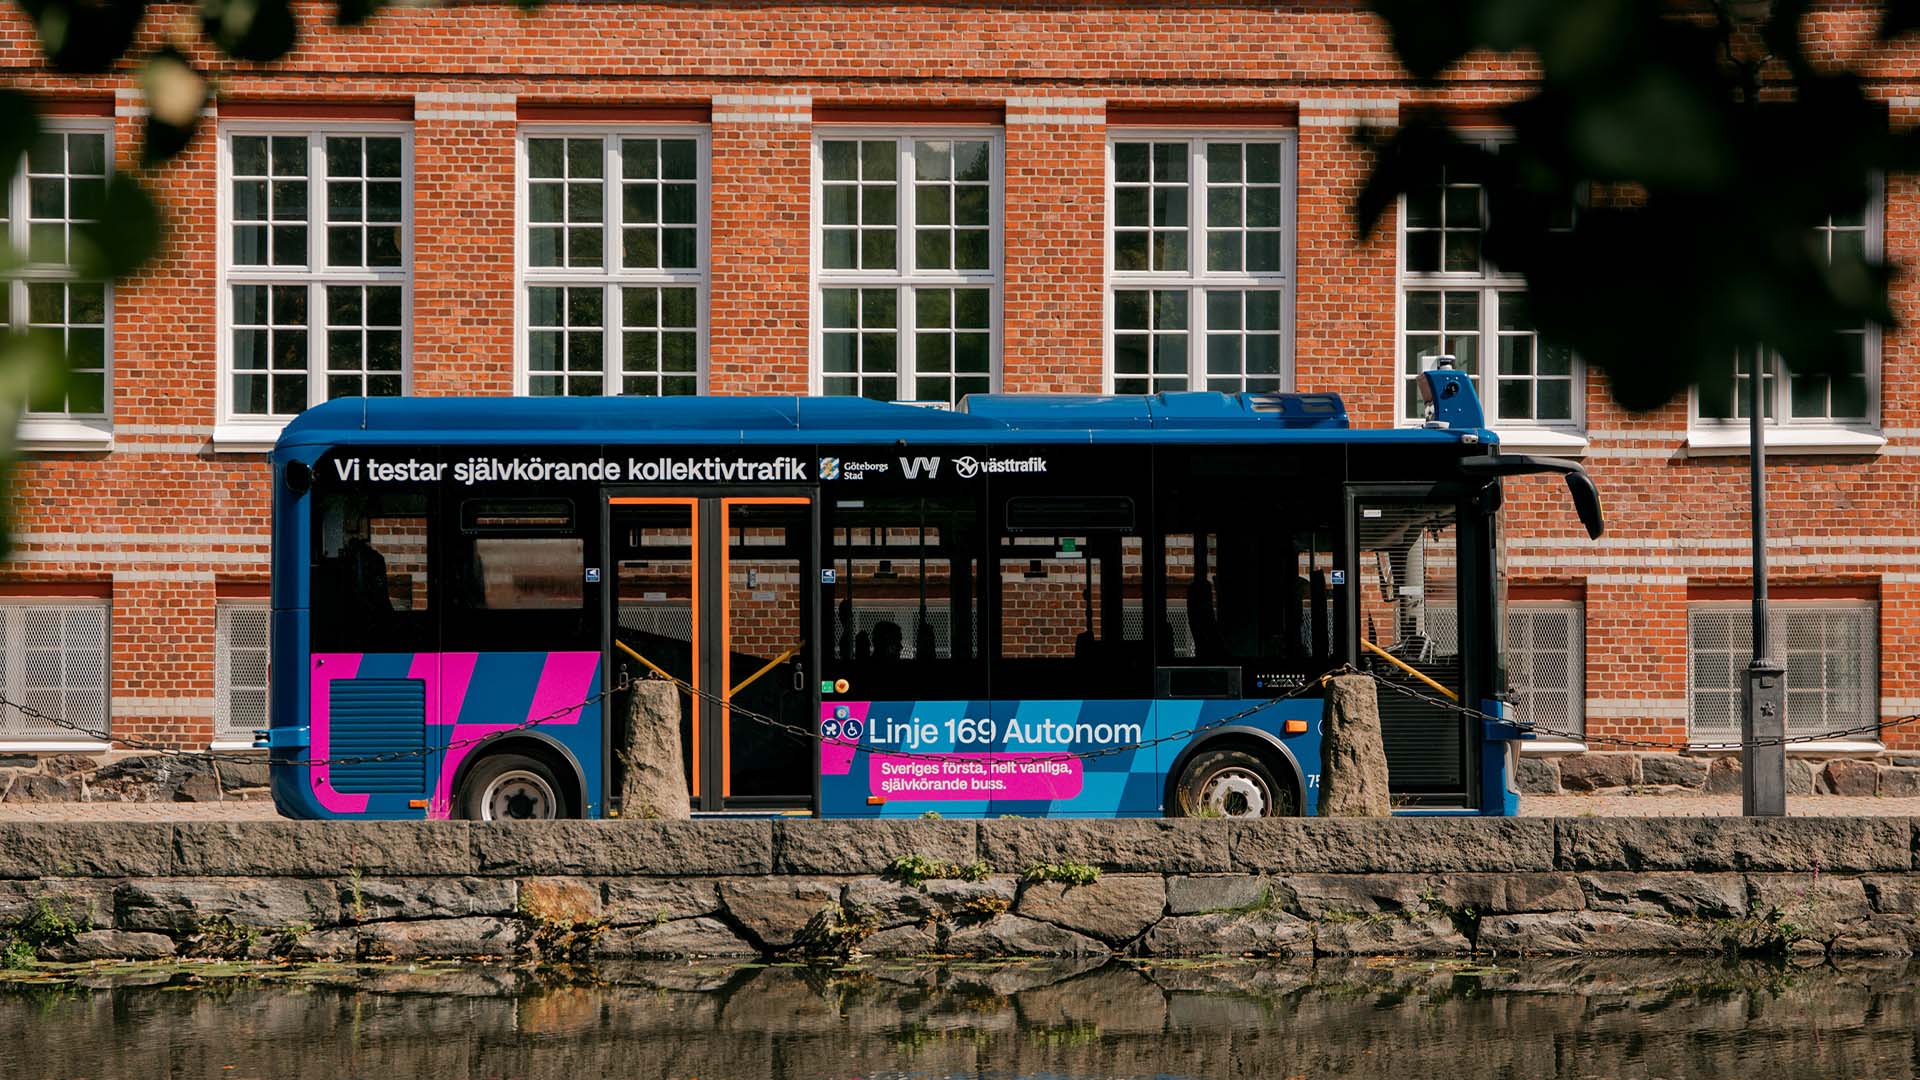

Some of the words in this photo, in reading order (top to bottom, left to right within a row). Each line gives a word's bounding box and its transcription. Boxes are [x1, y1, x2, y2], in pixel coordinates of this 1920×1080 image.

[334, 458, 360, 481] Vi
[367, 459, 447, 481] testar
[454, 457, 621, 485] självkörande
[628, 457, 807, 481] kollektivtrafik
[844, 461, 889, 473] Göteborgs
[981, 457, 1047, 473] västtrafik
[844, 471, 864, 480] Stad
[870, 718, 938, 749] Linje
[944, 718, 996, 744] 169
[1002, 718, 1142, 744] Autonom
[881, 763, 940, 777] Sveriges
[942, 762, 987, 776] första,
[1020, 761, 1073, 776] vanliga,
[881, 777, 968, 793] självkörande
[971, 777, 1007, 790] buss.
